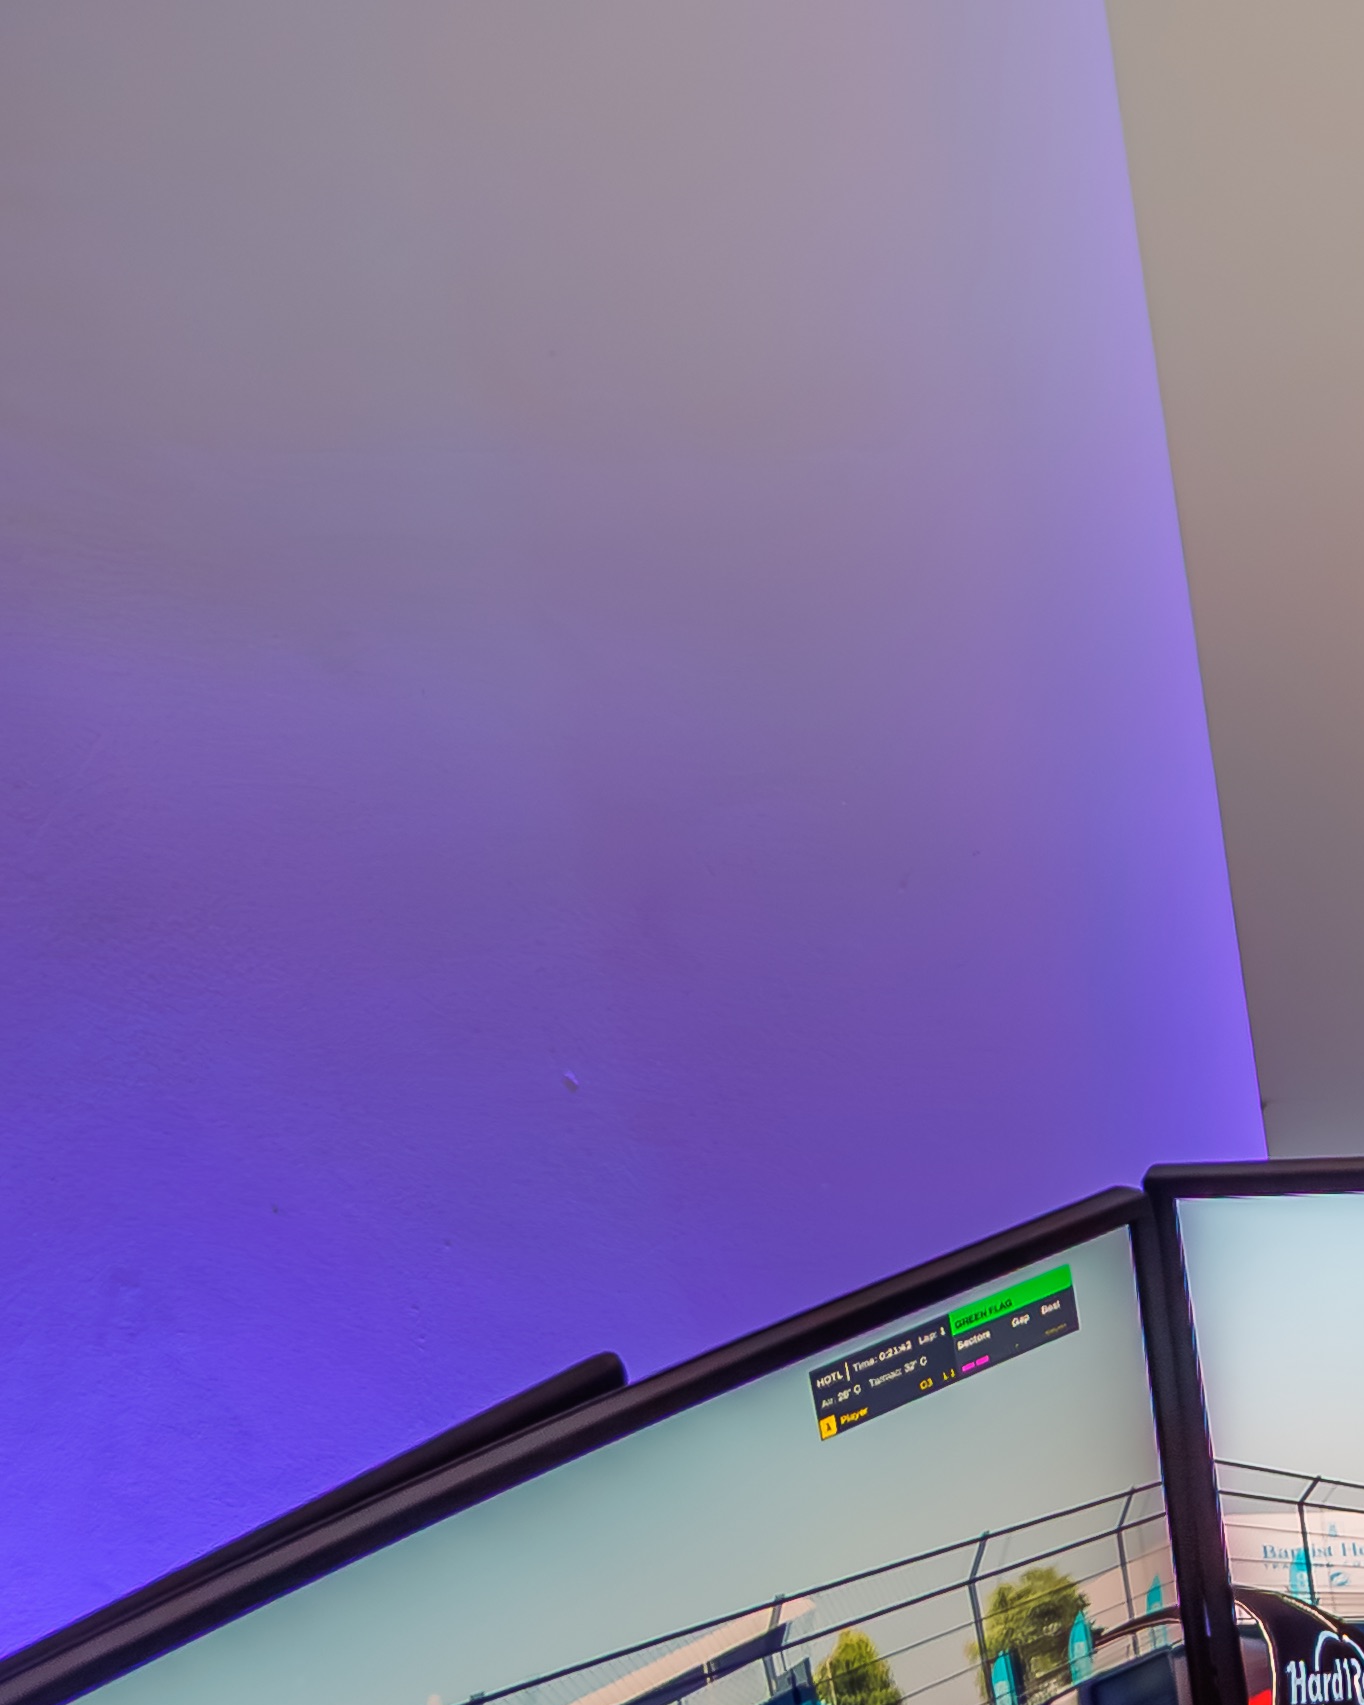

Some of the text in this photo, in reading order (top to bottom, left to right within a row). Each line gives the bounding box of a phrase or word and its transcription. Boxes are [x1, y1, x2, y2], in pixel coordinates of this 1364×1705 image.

[955, 1298, 1012, 1329] GREEN FLAG
[957, 1300, 1061, 1351] Sectors Gap Best
[840, 1407, 868, 1424] Player
[1285, 1659, 1344, 1705] Hard
